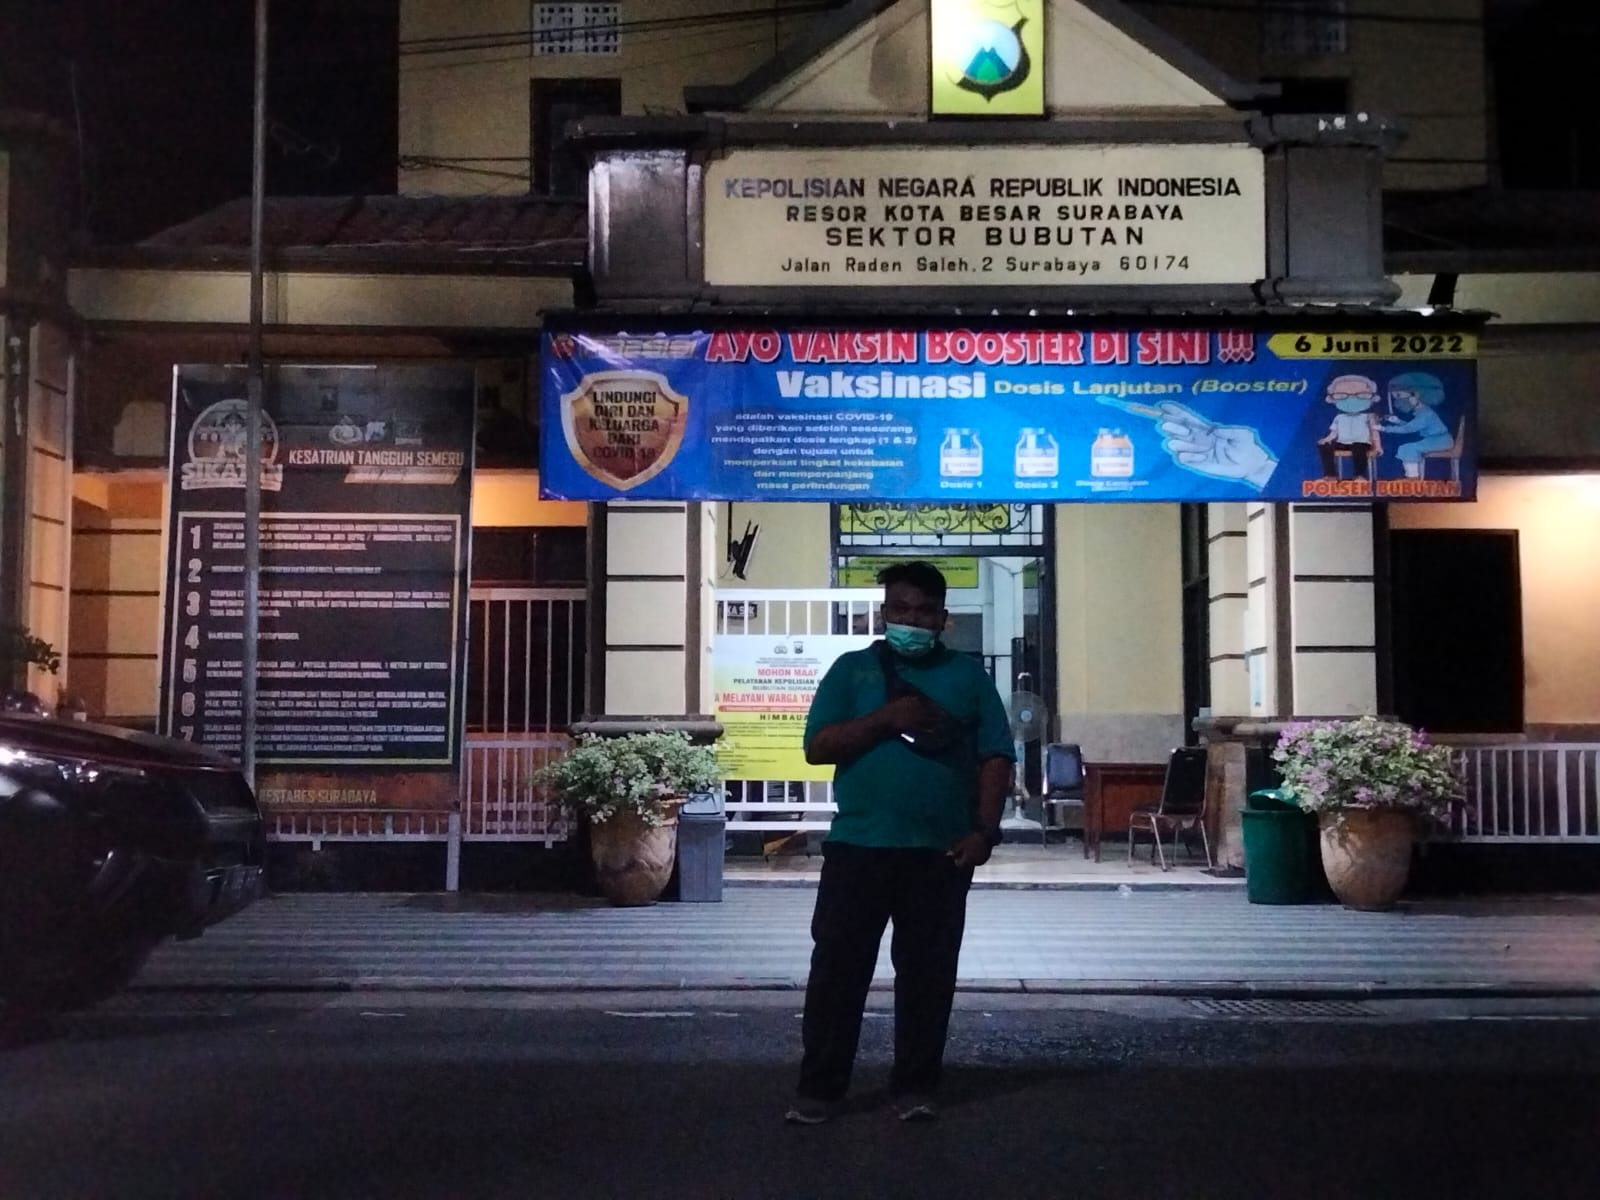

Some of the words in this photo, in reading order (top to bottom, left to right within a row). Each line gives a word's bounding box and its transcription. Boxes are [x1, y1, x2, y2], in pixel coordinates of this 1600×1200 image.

[725, 177, 865, 198] KEPOLISIAN
[879, 177, 976, 198] NEGARA
[990, 177, 1103, 198] REPUBLIK
[1118, 177, 1241, 197] INDONESIA
[786, 205, 867, 222] RESOR
[885, 205, 945, 222] KOTA
[960, 204, 1041, 222] BESAR
[1057, 204, 1184, 221] SURABAYA
[826, 227, 957, 247] SEKTOR
[986, 226, 1144, 247] BUBUTAN
[781, 256, 831, 273] Jalan
[845, 256, 902, 273] Raden
[1006, 256, 1101, 275] Surabaya
[1119, 256, 1190, 272] 60174
[705, 328, 782, 364] AYO
[789, 328, 918, 364] VAKSIN
[926, 329, 1083, 366] BOOSTER
[1092, 329, 1128, 364] DI
[1137, 328, 1210, 364] SINI
[1295, 335, 1310, 353] 6
[1323, 333, 1379, 355] Juni
[1392, 333, 1463, 354] 2022
[776, 370, 987, 399] Vaksinasi
[994, 379, 1065, 396] Dosis
[1073, 379, 1183, 398] Lanjutan
[1192, 378, 1308, 397] (Booster)
[592, 391, 657, 404] LINDUNGI
[594, 405, 623, 417] DIRI
[627, 405, 655, 417] DAN
[778, 413, 833, 421] vaksinasi
[836, 413, 894, 421] COVID-19
[589, 418, 660, 431] KELUARGA
[715, 425, 744, 433] yang
[748, 424, 802, 432] diberikan
[608, 432, 641, 445] DARI
[289, 450, 355, 465] KESATRIAN
[358, 451, 414, 466] TANGGUH
[416, 452, 466, 466] SEMERU
[800, 447, 838, 456] tujuan
[840, 448, 875, 456] untuk
[1302, 479, 1374, 498] POLSEK
[1375, 480, 1463, 498] BUBUTAN
[189, 525, 201, 550] 1
[187, 558, 202, 583] 2
[186, 591, 200, 616] 3
[184, 625, 199, 650] 4
[182, 658, 197, 683] 5
[757, 668, 791, 677] MOHON
[793, 668, 819, 677] MAAF
[181, 691, 195, 717] 6
[722, 692, 765, 703] MELAYANI
[767, 693, 799, 703] WARGA
